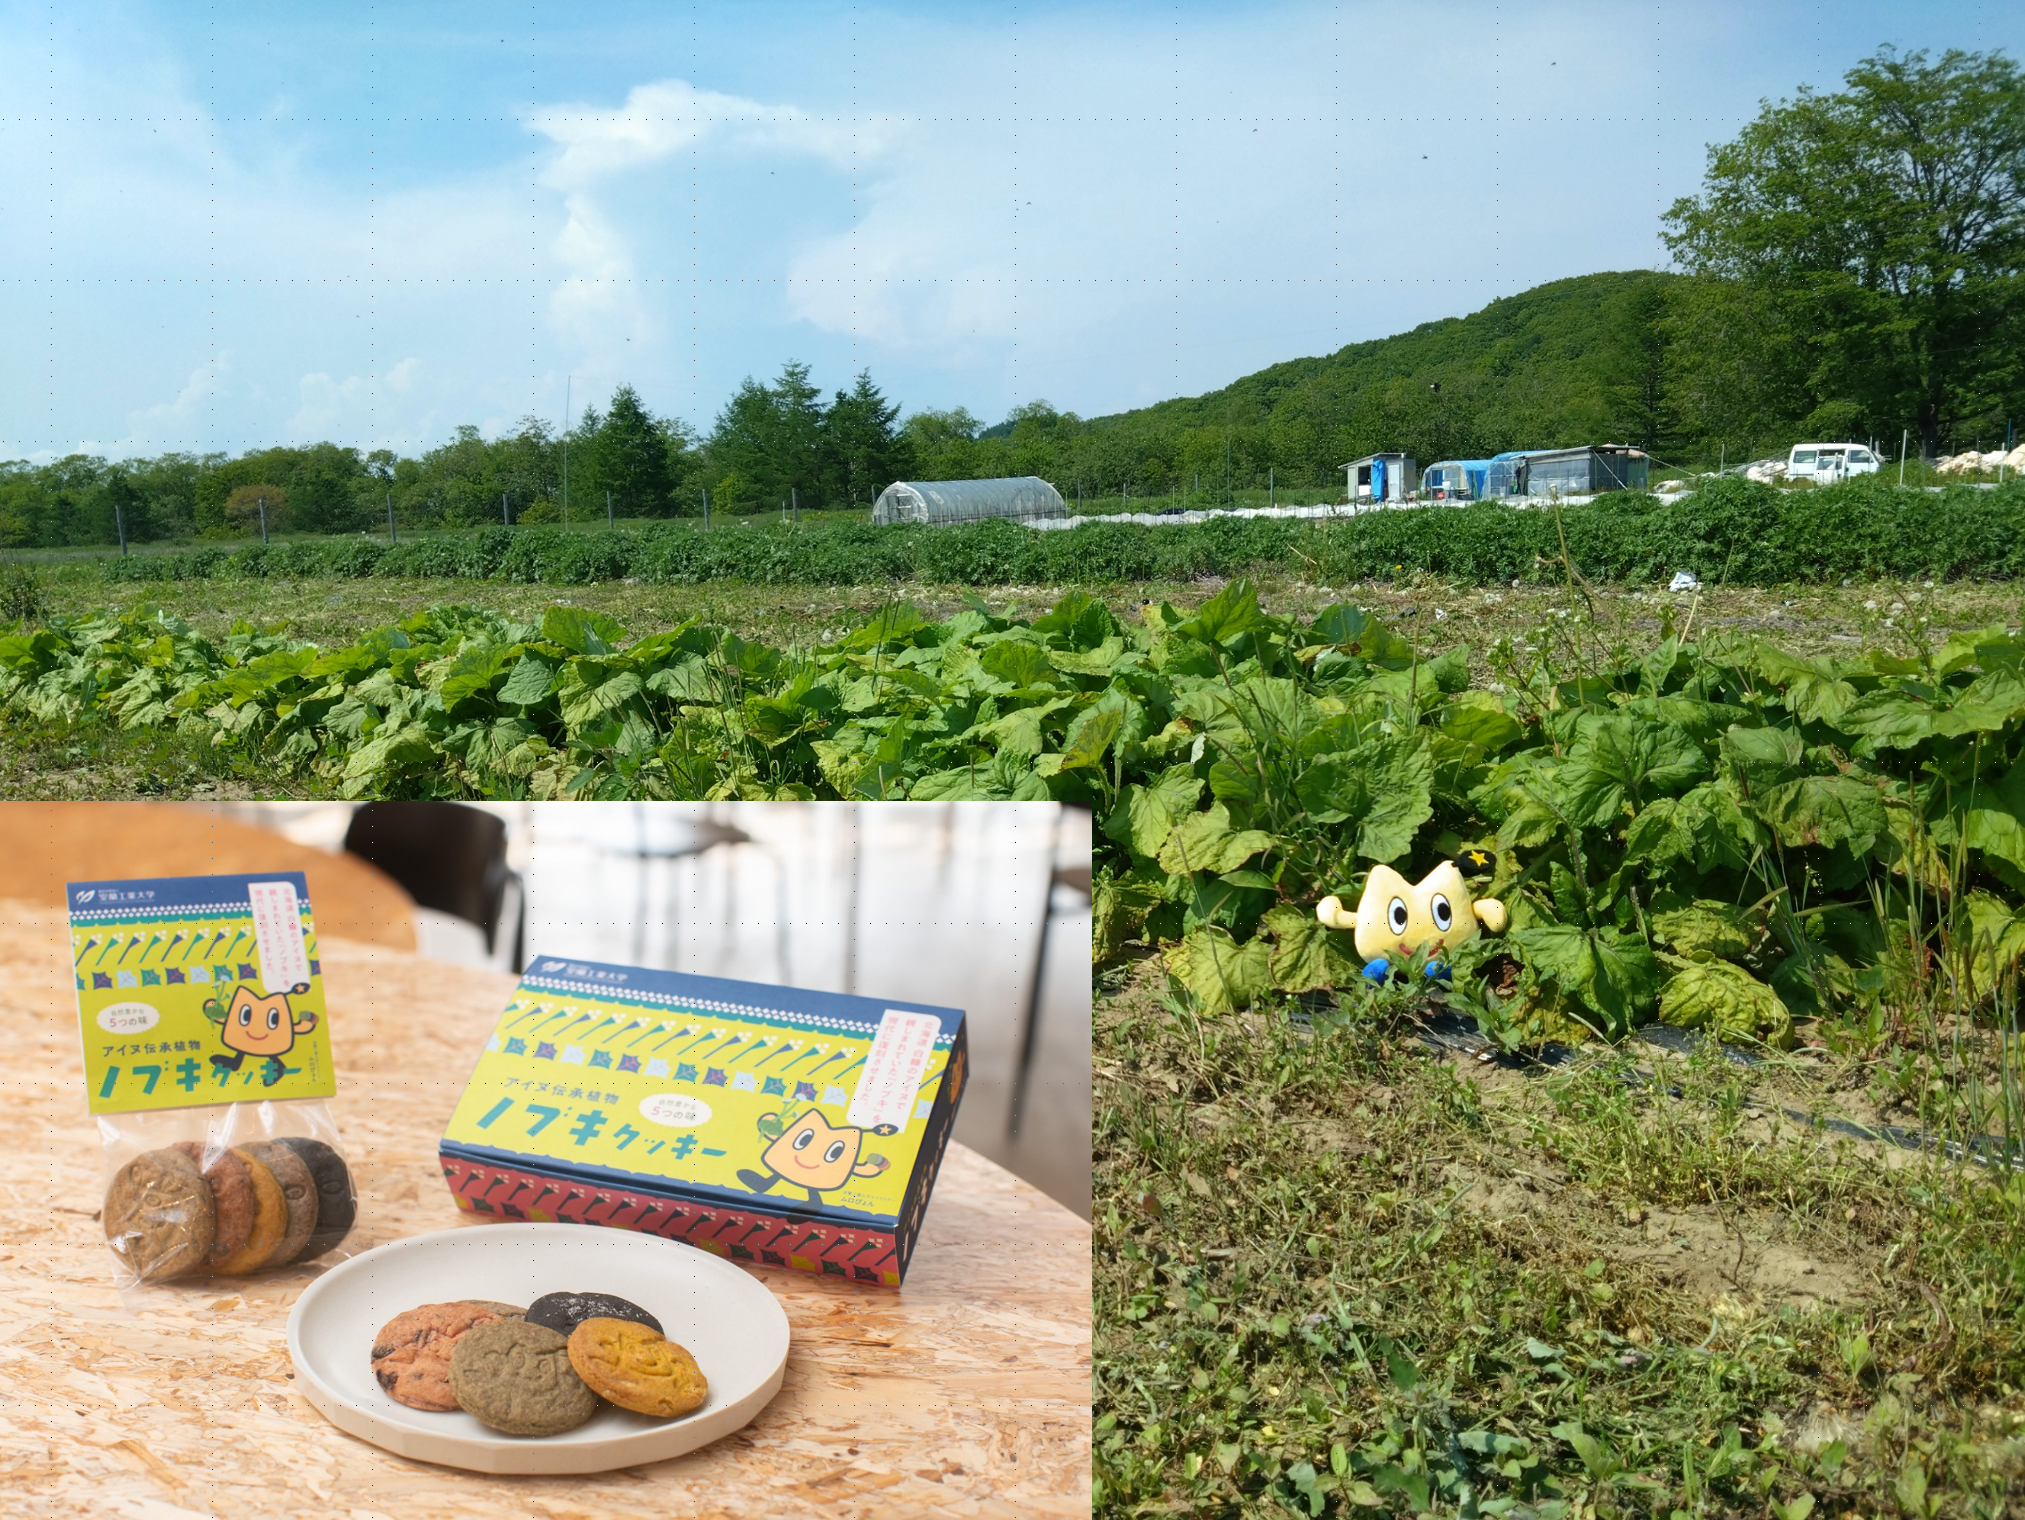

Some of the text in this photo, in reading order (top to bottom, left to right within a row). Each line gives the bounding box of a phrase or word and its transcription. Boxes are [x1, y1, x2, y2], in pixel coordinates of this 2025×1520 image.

[102, 1040, 201, 1057] アイヌ伝承植物
[504, 1076, 619, 1105] アイヌ伝承植物
